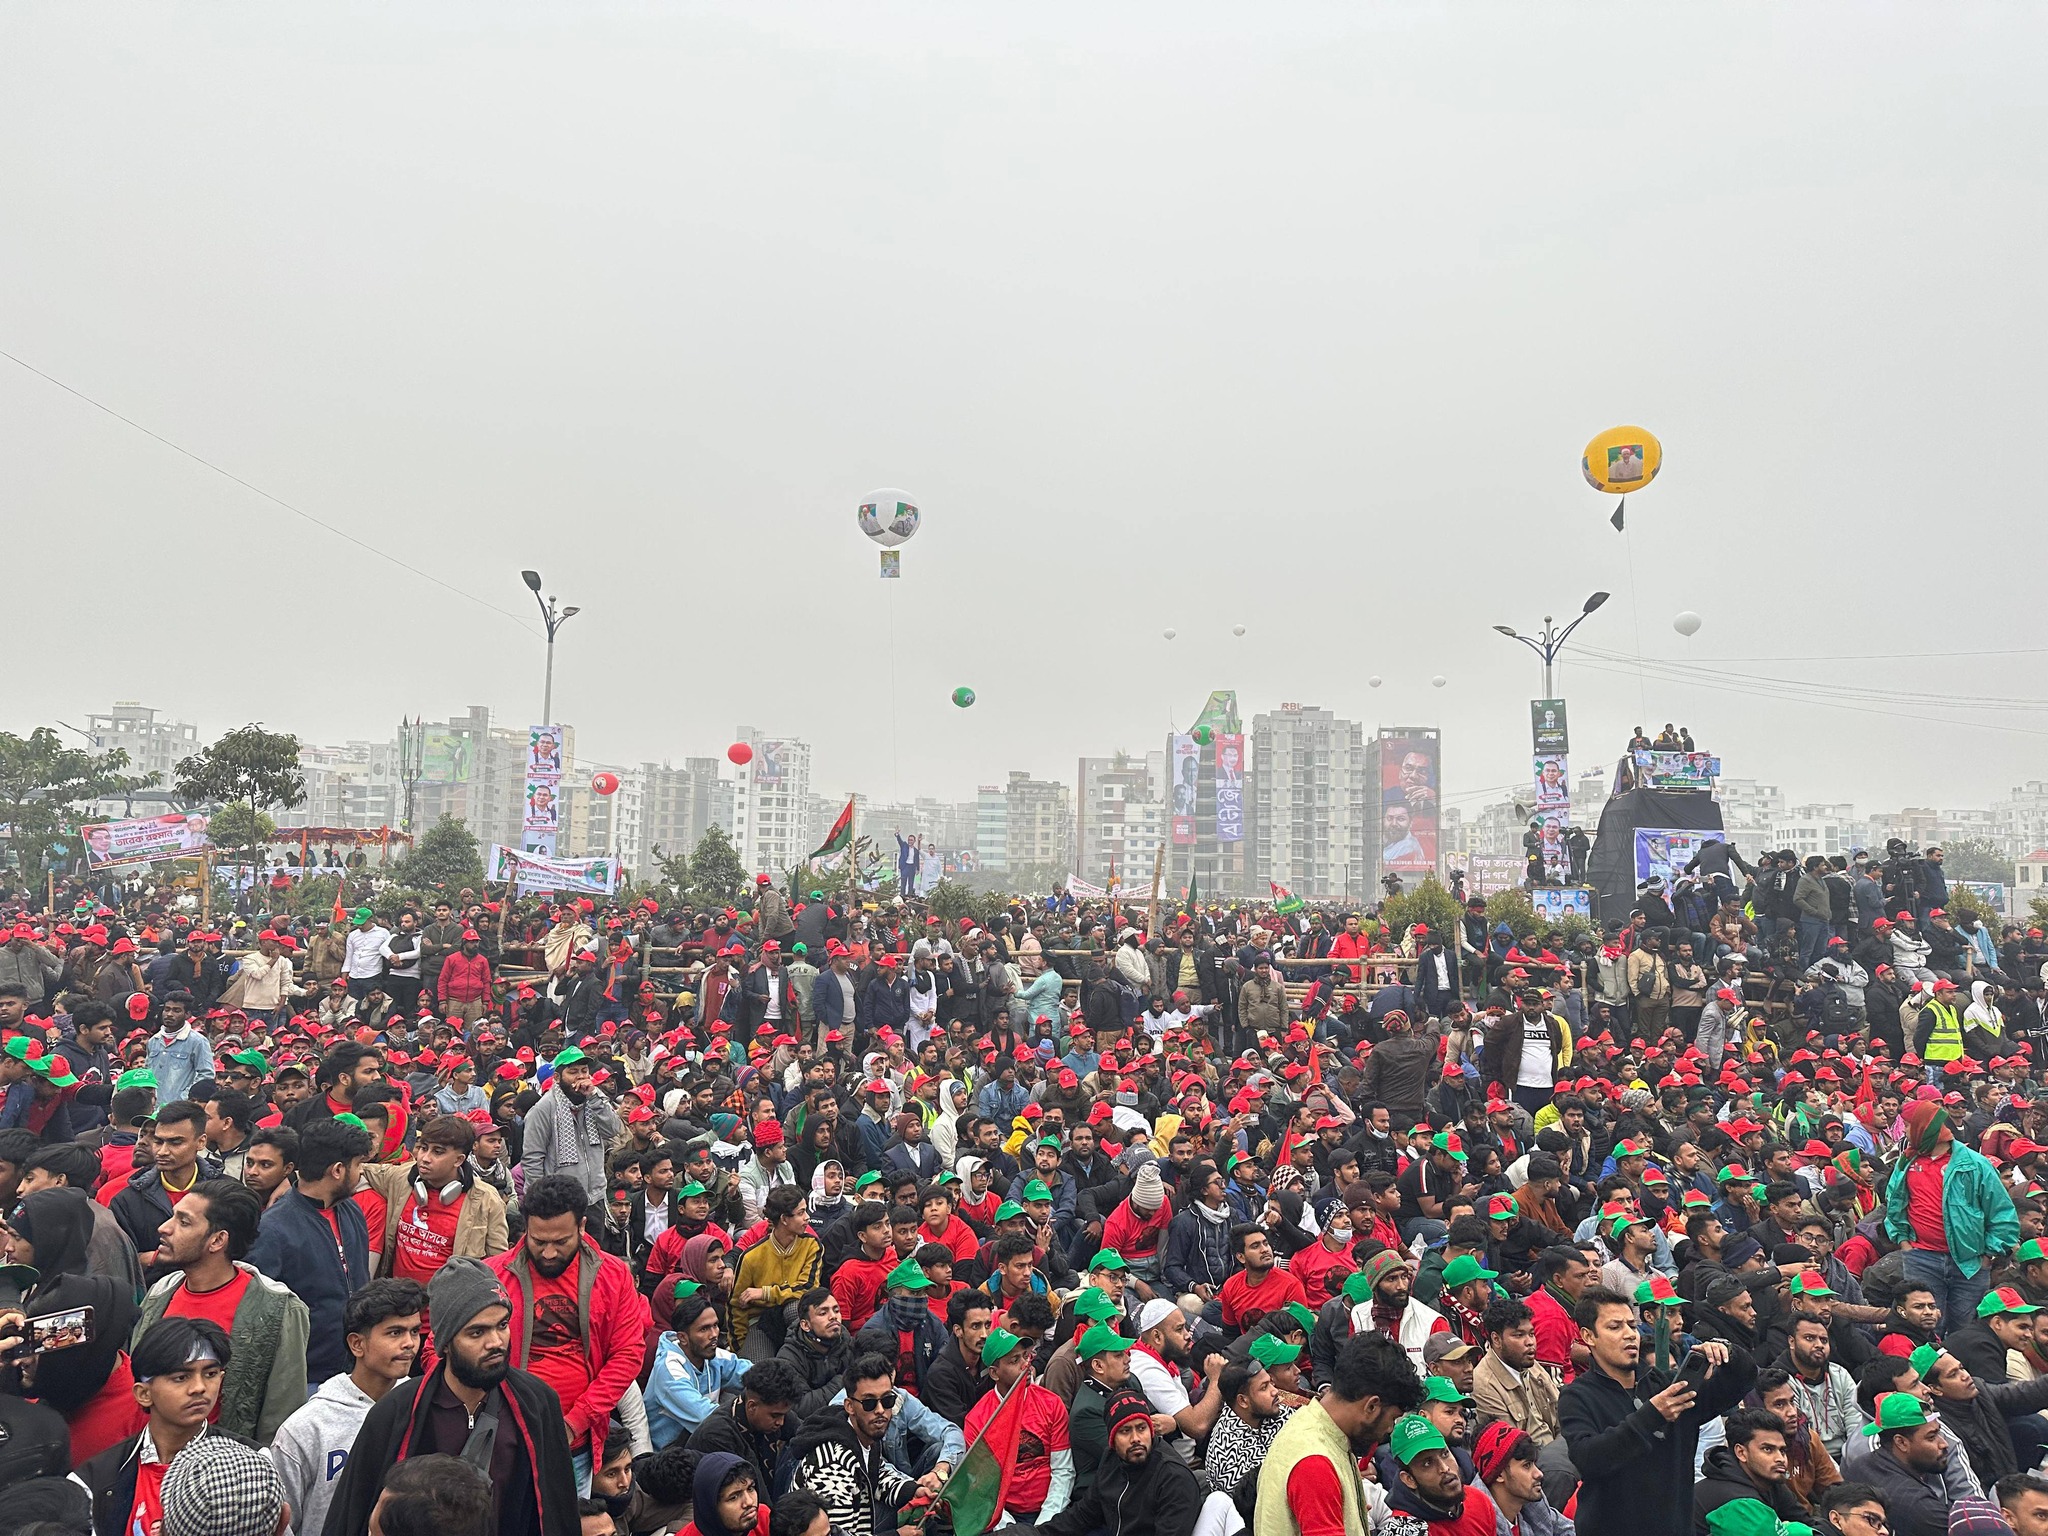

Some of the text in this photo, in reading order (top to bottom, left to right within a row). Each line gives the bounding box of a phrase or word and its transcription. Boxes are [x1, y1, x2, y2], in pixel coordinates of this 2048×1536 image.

[115, 836, 144, 847] তারেক
[1473, 856, 1522, 868] প্রিয় তারেক
[1474, 869, 1491, 881] তুমি
[419, 1228, 449, 1246] আসছে
